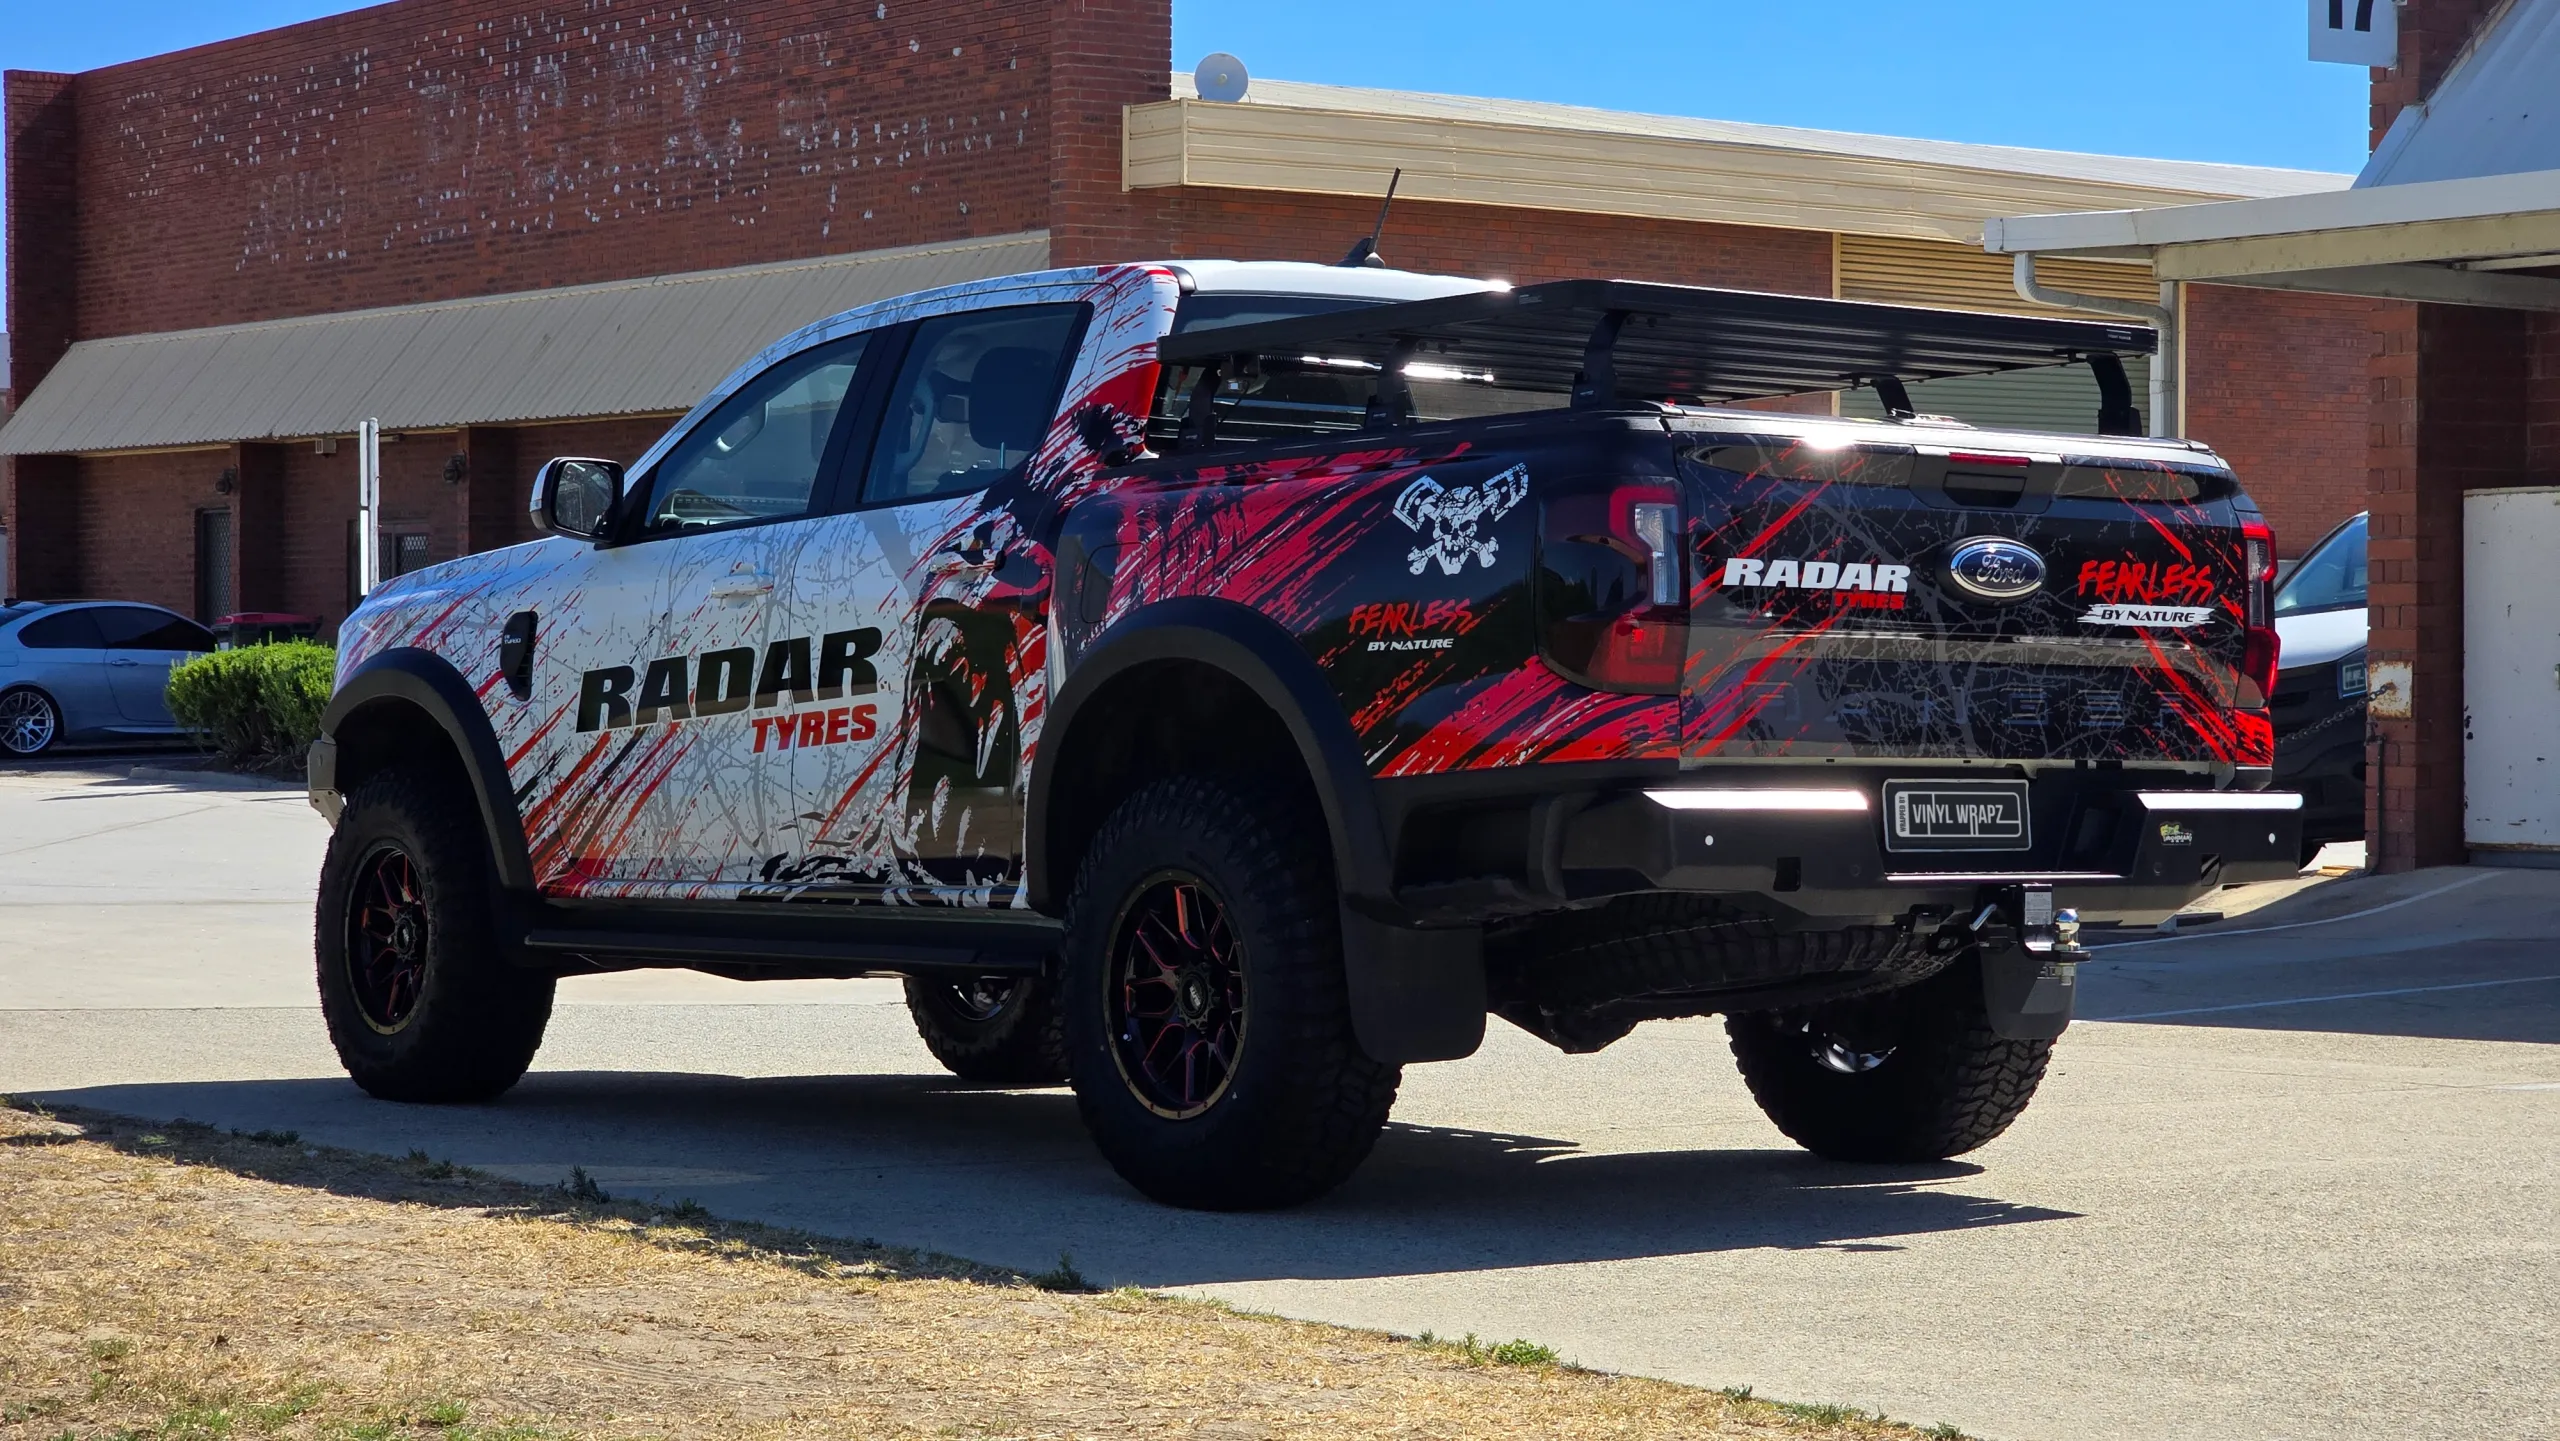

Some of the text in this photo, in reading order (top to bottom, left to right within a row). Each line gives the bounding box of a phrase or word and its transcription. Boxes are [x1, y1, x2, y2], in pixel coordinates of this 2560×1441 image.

[1723, 558, 1911, 592] RADAR
[1976, 554, 2027, 584] Ford
[2078, 560, 2214, 605] FEARLESS
[1834, 592, 1906, 609] TYRES
[2101, 609, 2195, 622] BY NATURE
[1349, 598, 1473, 639] FEARLESS
[1367, 638, 1454, 652] BY NATURE
[575, 626, 884, 734] RADAR
[751, 703, 877, 753] TYRES
[1913, 804, 2004, 824] VINYL WRAPZ
